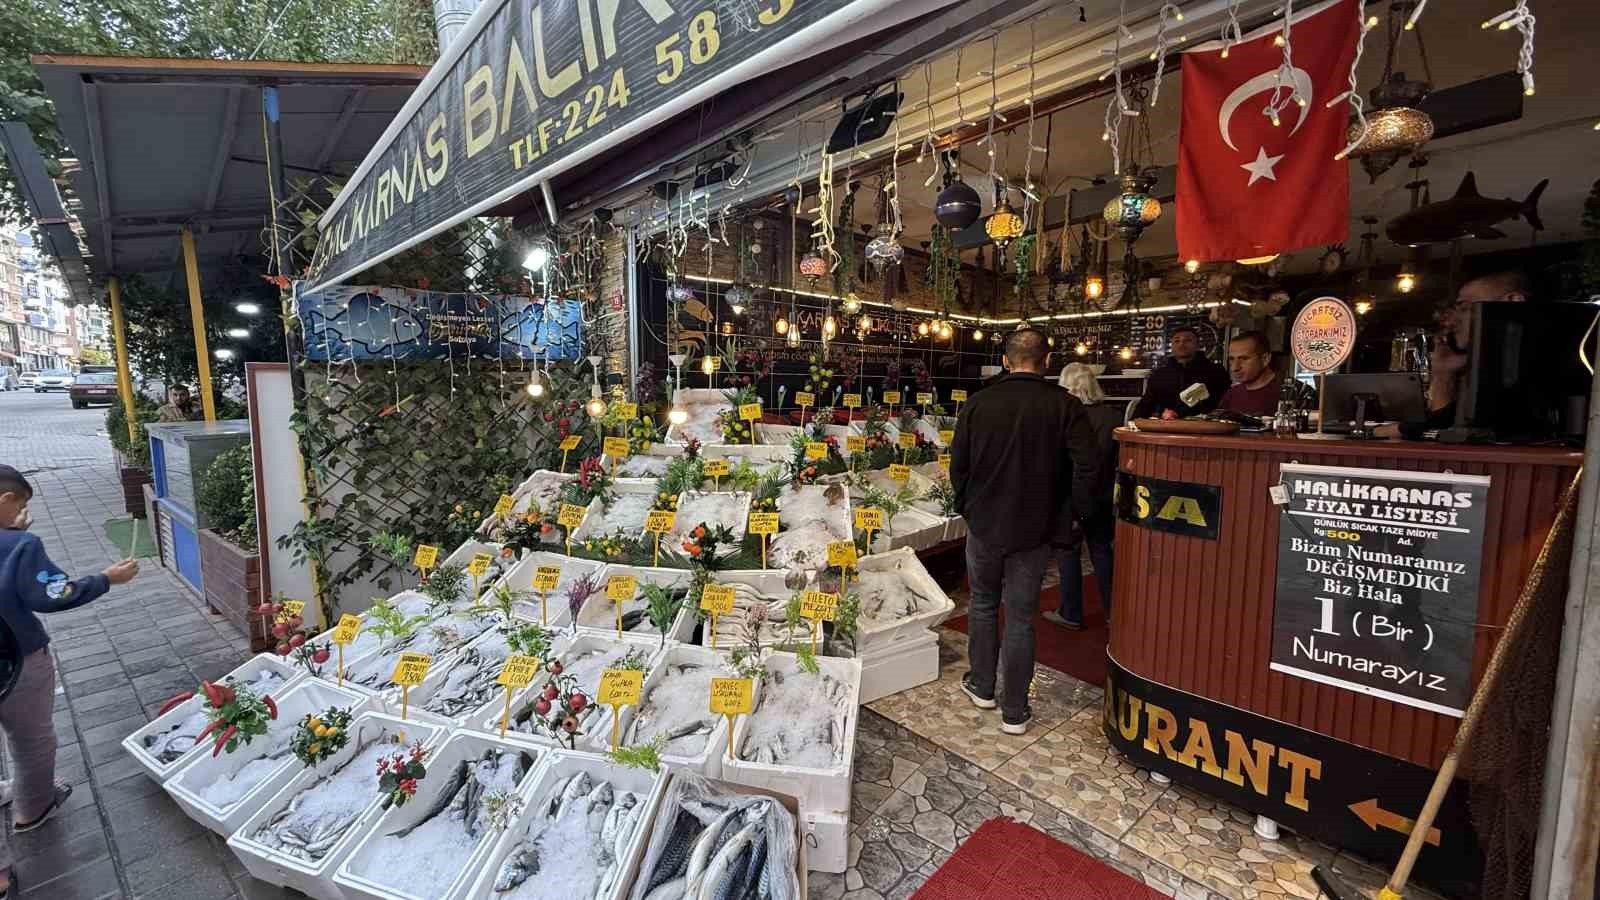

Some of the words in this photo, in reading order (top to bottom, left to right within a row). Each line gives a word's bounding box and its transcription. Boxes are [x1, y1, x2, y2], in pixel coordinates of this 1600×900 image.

[655, 12, 720, 86] 58
[1146, 315, 1164, 329] 80
[1294, 480, 1472, 509] HALİKARNAS
[1305, 496, 1364, 517] FİYAT
[1371, 502, 1458, 527] LİSTESİ
[1314, 518, 1349, 530] GÜNLÜK
[1351, 522, 1378, 533] SICAK
[1381, 525, 1404, 536] TAZE
[1406, 527, 1439, 540] MİDYE
[1291, 537, 1341, 559] Bizim
[1347, 545, 1465, 575] Numaramız
[1306, 558, 1450, 593] DEĞİŞMEDİKİ
[1323, 578, 1352, 597] Biz
[1358, 584, 1403, 605] Hala
[1312, 597, 1341, 636] 1
[1371, 614, 1413, 642] Bir
[1292, 636, 1447, 692] Numarayız
